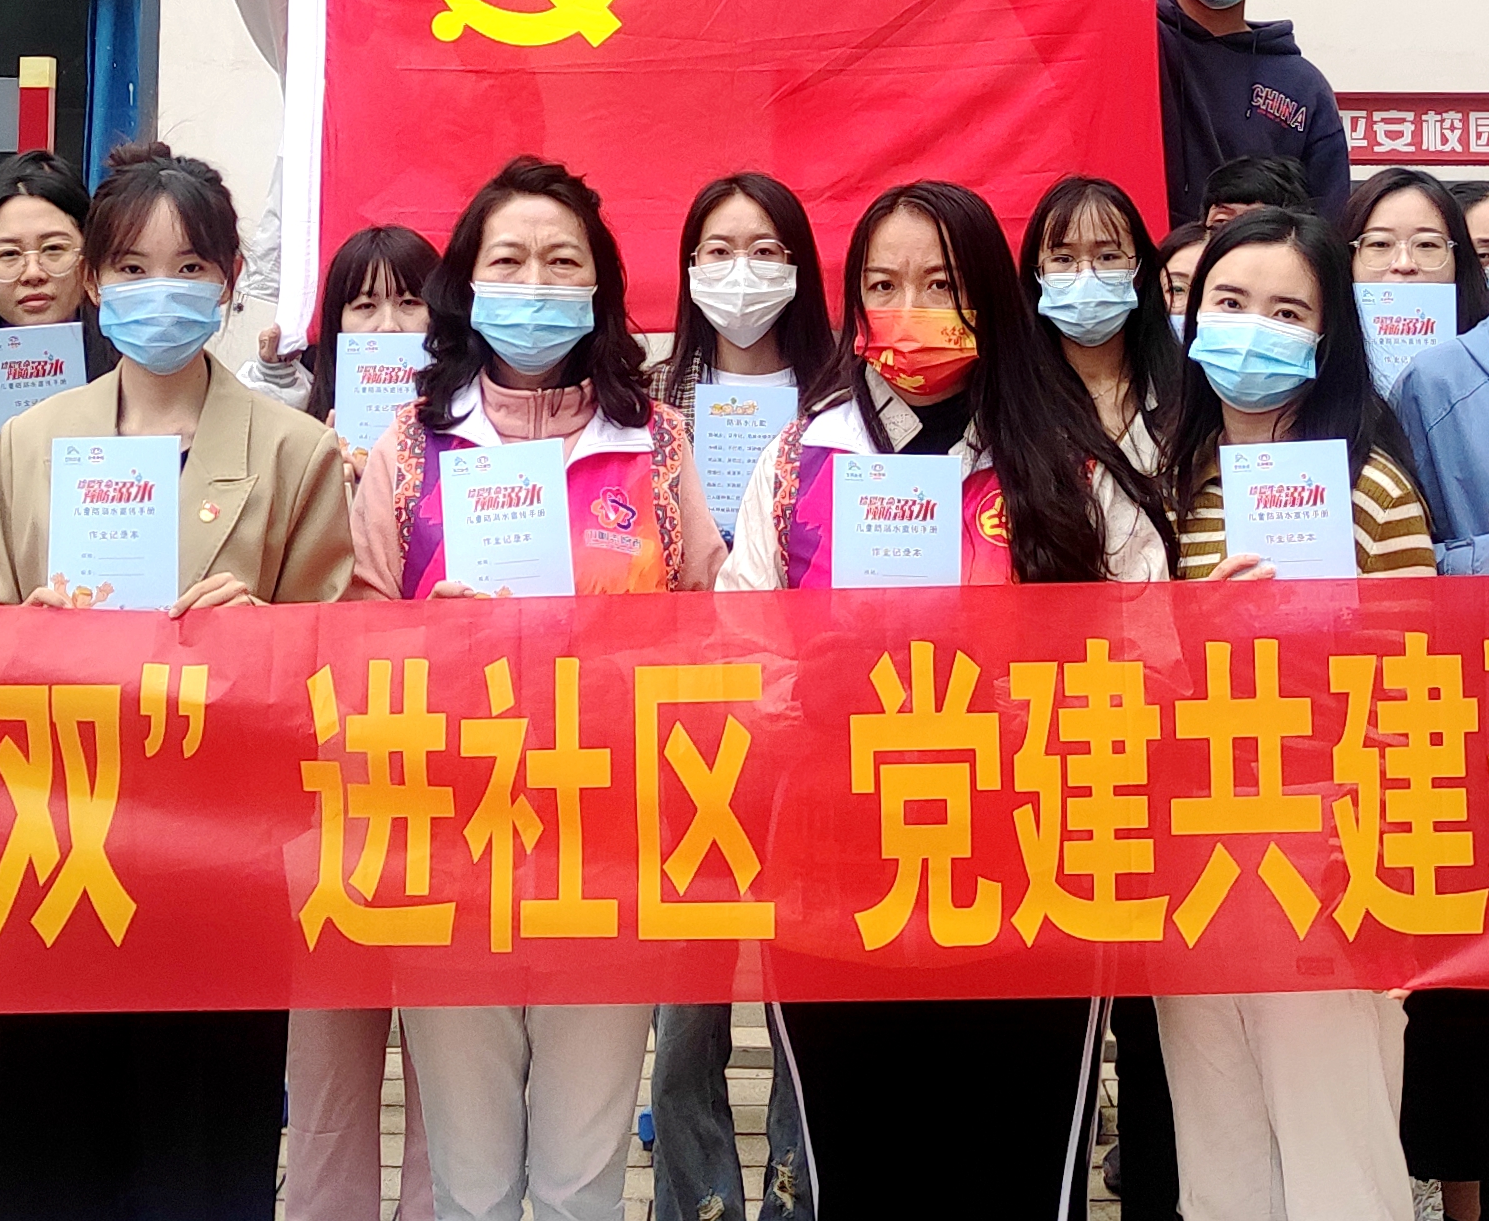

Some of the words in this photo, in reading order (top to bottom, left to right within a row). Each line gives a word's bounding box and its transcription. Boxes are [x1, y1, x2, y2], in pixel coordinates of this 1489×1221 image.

[1251, 84, 1307, 132] CHINA
[298, 658, 776, 952] 进社区
